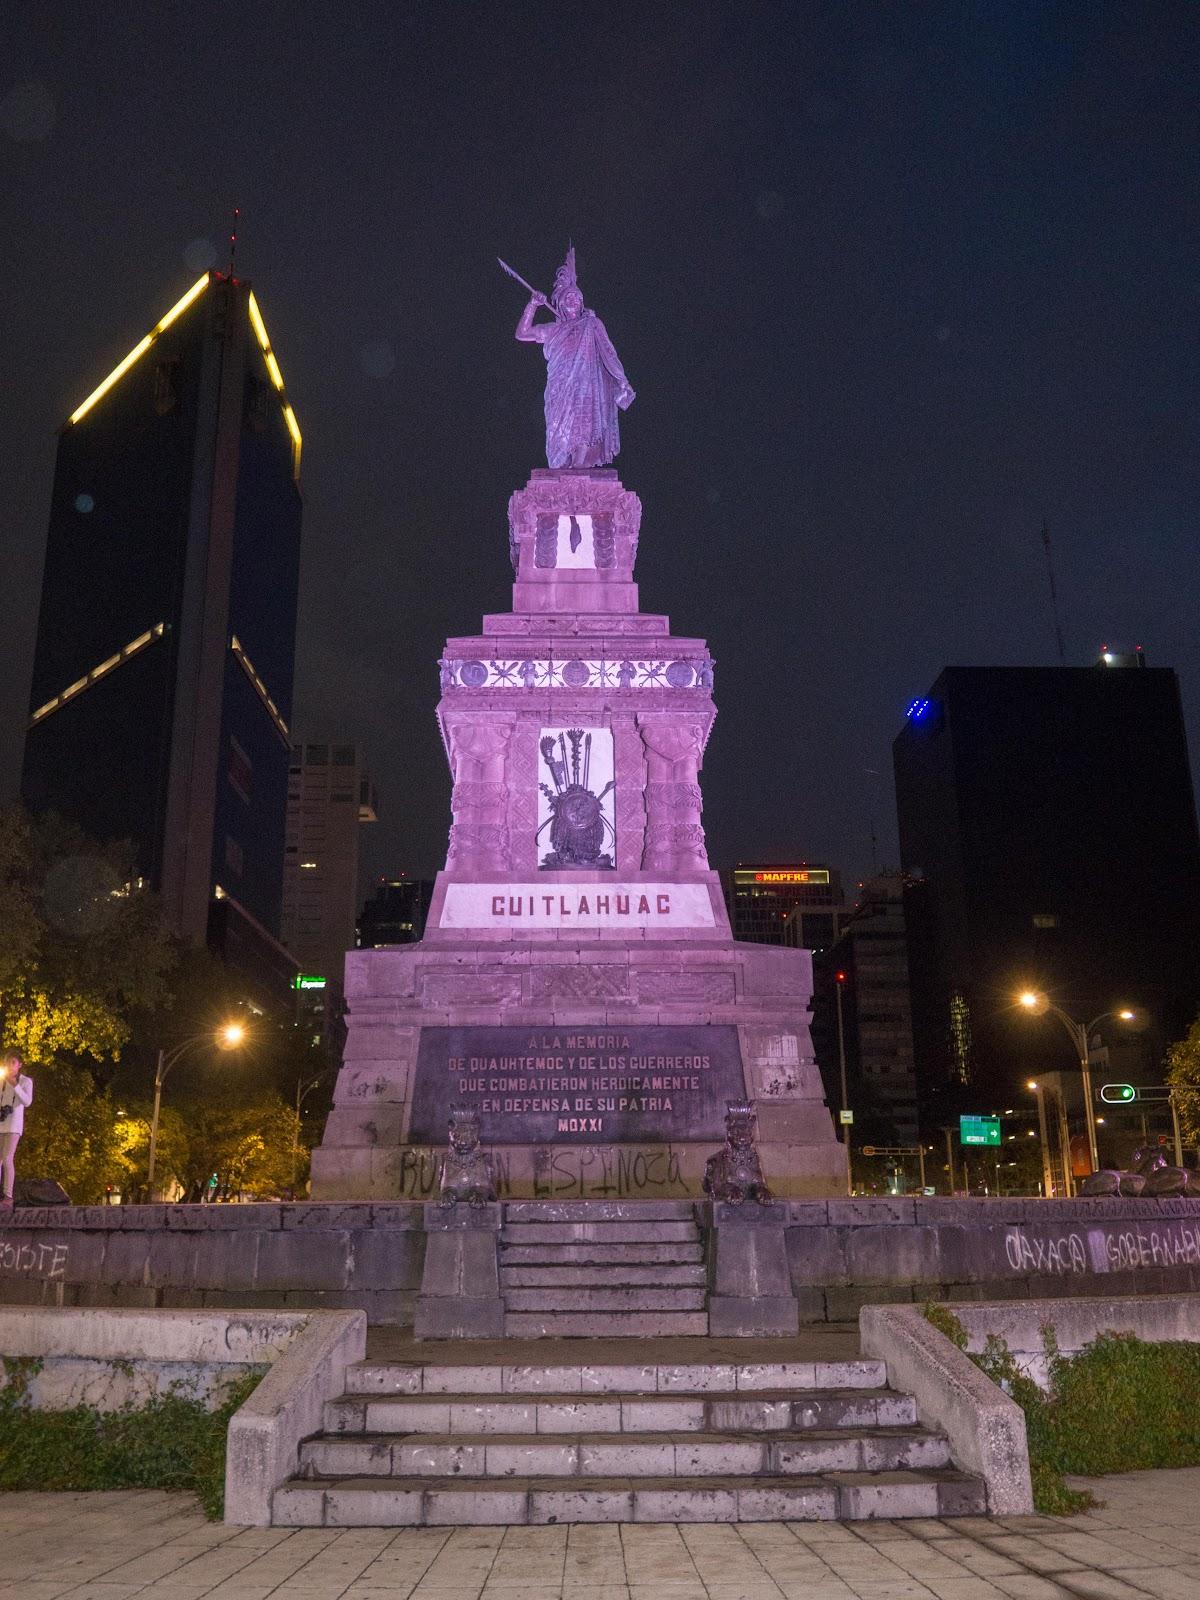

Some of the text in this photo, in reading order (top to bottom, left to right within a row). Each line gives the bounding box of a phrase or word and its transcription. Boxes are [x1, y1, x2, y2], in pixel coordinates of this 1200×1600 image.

[763, 873, 808, 881] MAPFRE
[492, 894, 670, 916] CUITLAHUAC
[529, 1035, 630, 1049] A LA MEMORIA
[448, 1056, 710, 1073] DE QUAUHTEMOC Y DE LOS GUERREROS
[460, 1077, 699, 1094] QUE COMBATIERON HEROICAMENTE
[482, 1097, 672, 1112] EN DEFENSA DE SU PATRIA
[1006, 1226, 1087, 1274] OAXACA
